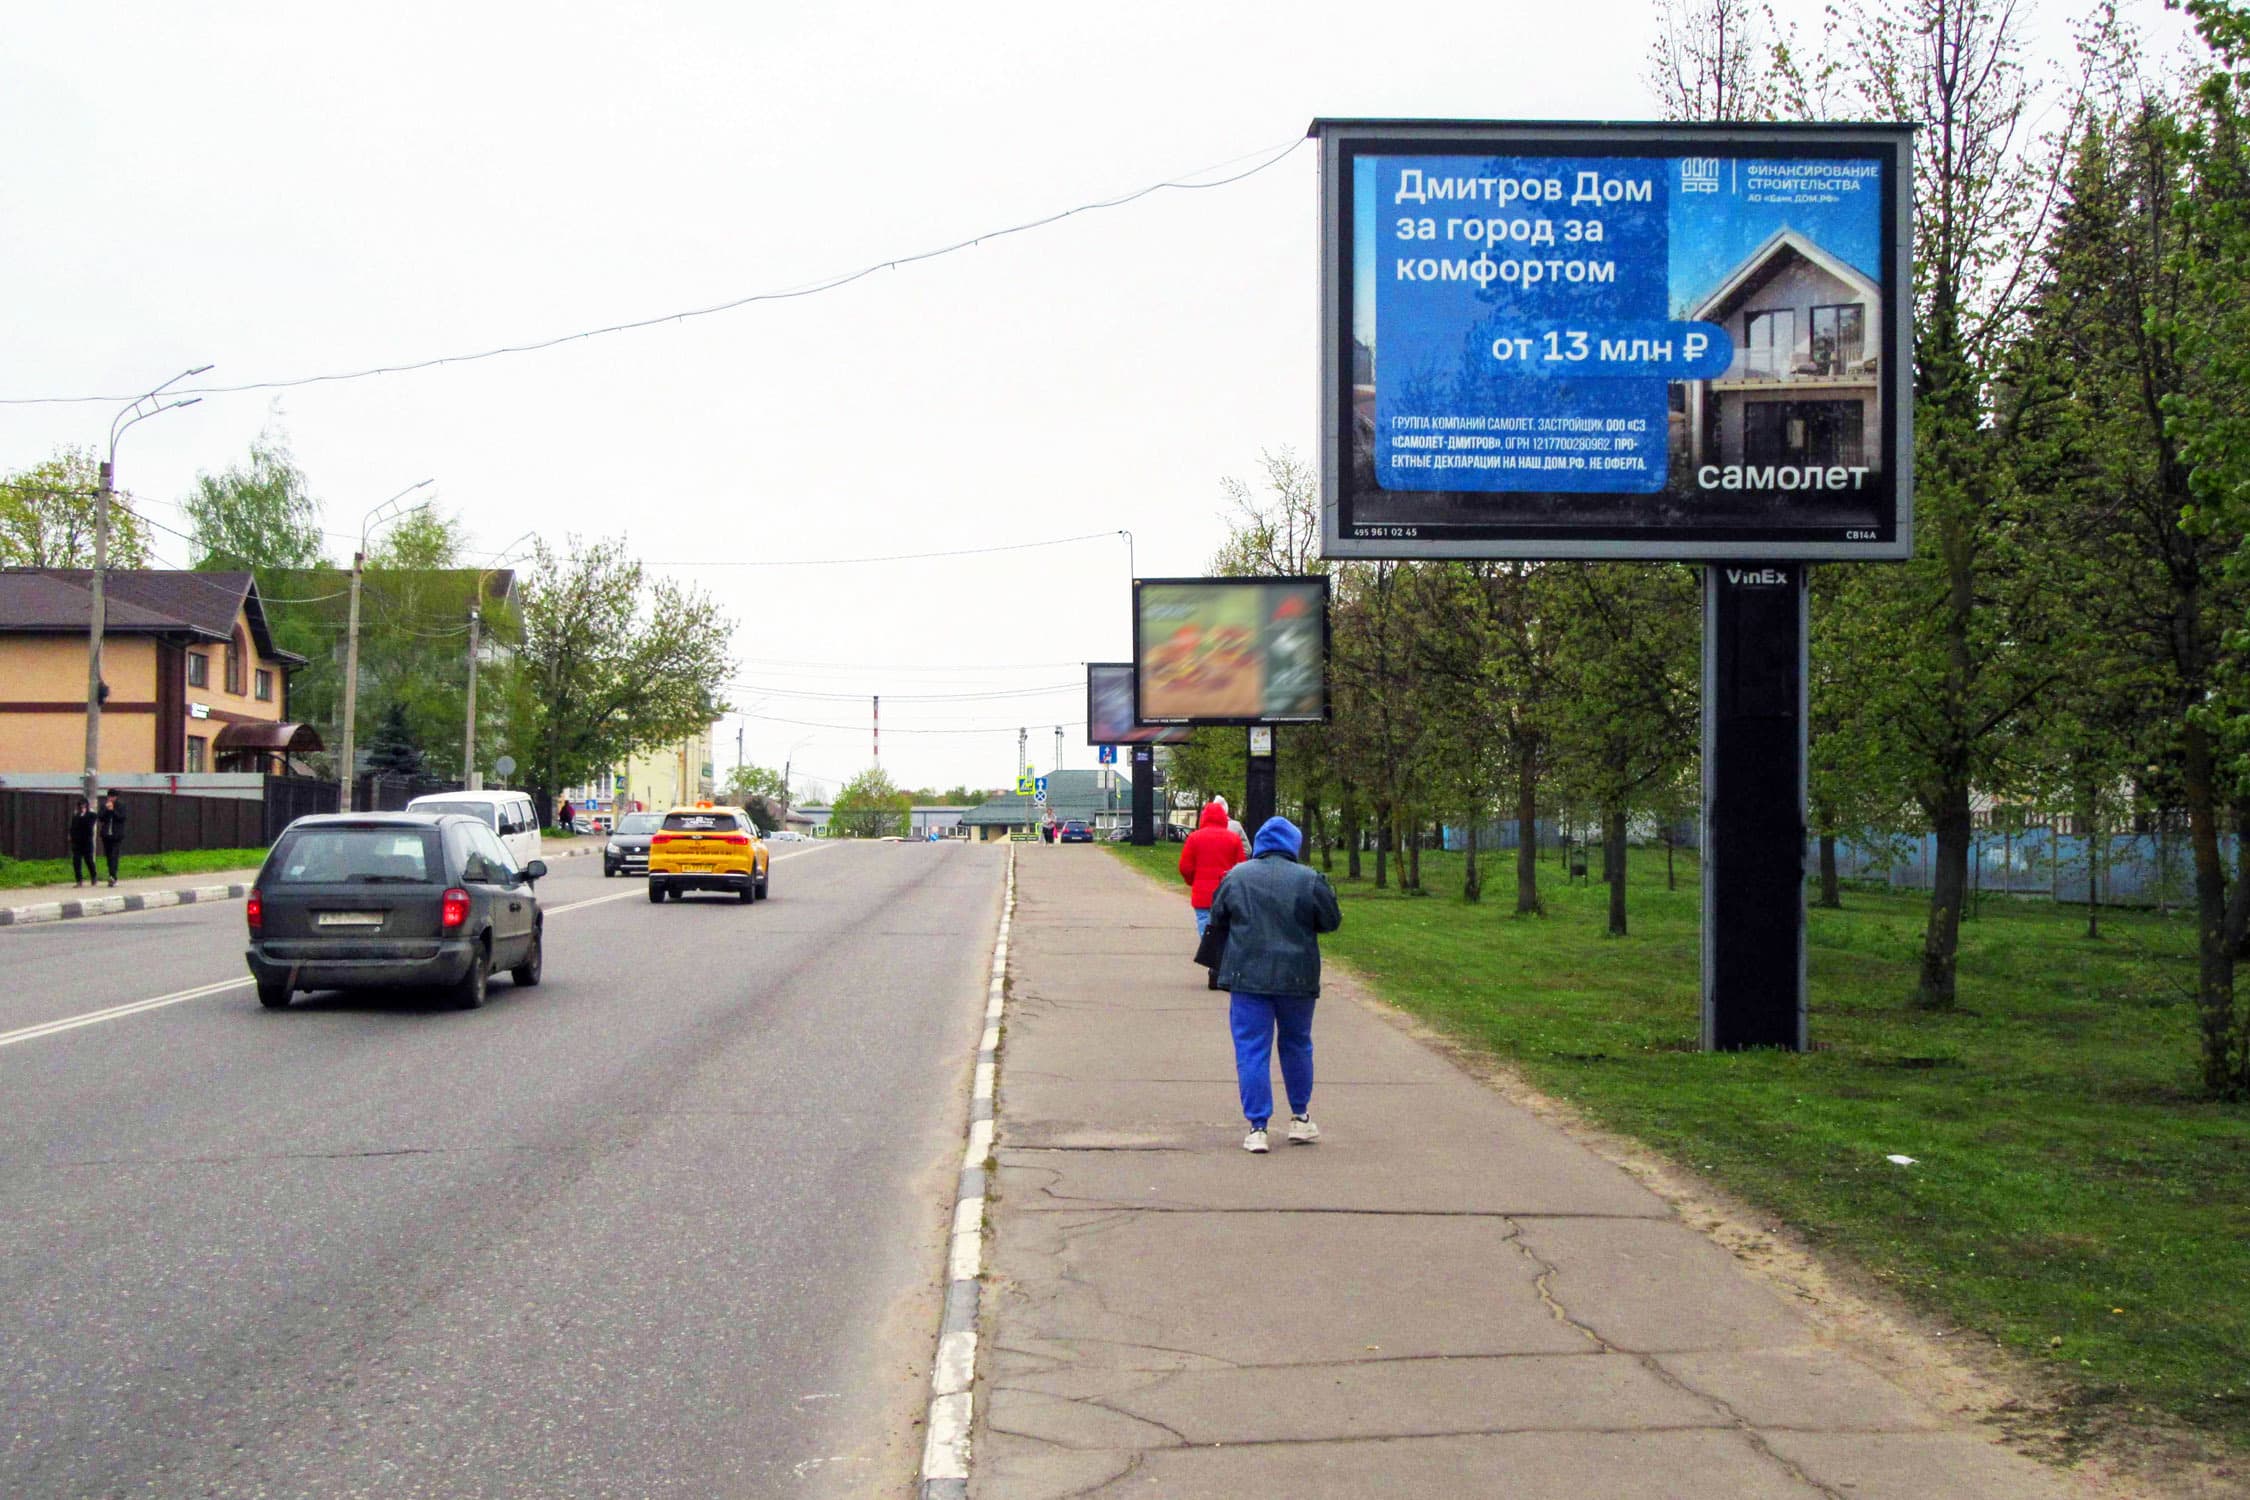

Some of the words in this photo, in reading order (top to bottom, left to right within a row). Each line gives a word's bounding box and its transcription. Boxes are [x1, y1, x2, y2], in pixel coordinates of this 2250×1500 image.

[1748, 165, 1879, 177] ФИНАНСИРОВАНИЕ
[1395, 169, 1562, 207] Дмитров
[1571, 171, 1652, 206] Дом
[1747, 178, 1861, 191] СТРОИТЕЛЬСТВА
[1396, 218, 1436, 240] за
[1447, 218, 1555, 248] город
[1563, 218, 1603, 241] за
[1397, 252, 1615, 289] комфортом
[1492, 338, 1533, 361] от
[1543, 331, 1589, 361] 13
[1600, 338, 1672, 362] млн
[1392, 416, 1430, 429] ГРУППА
[1432, 415, 1485, 430] КОМПАНИЙ
[1488, 417, 1536, 431] САМОЛЕТ.
[1538, 416, 1603, 432] ЗАСТРОЙЩИК
[1606, 418, 1625, 431] ООО
[1505, 437, 1529, 450] ОГРН
[1614, 438, 1638, 451] ПРО-
[1392, 455, 1431, 467] ЕКТНЫЕ
[1434, 455, 1500, 469] ДЕКЛАРАЦИИ
[1502, 456, 1517, 468] НА
[1590, 457, 1603, 469] НЕ
[1604, 457, 1647, 470] ОФЕРТА.
[1698, 464, 1869, 490] самолет
[1354, 528, 1369, 536] 495
[1371, 527, 1388, 537] 961
[1391, 527, 1403, 537] 02
[1405, 527, 1417, 537] 45
[1726, 568, 1788, 585] VinEx
